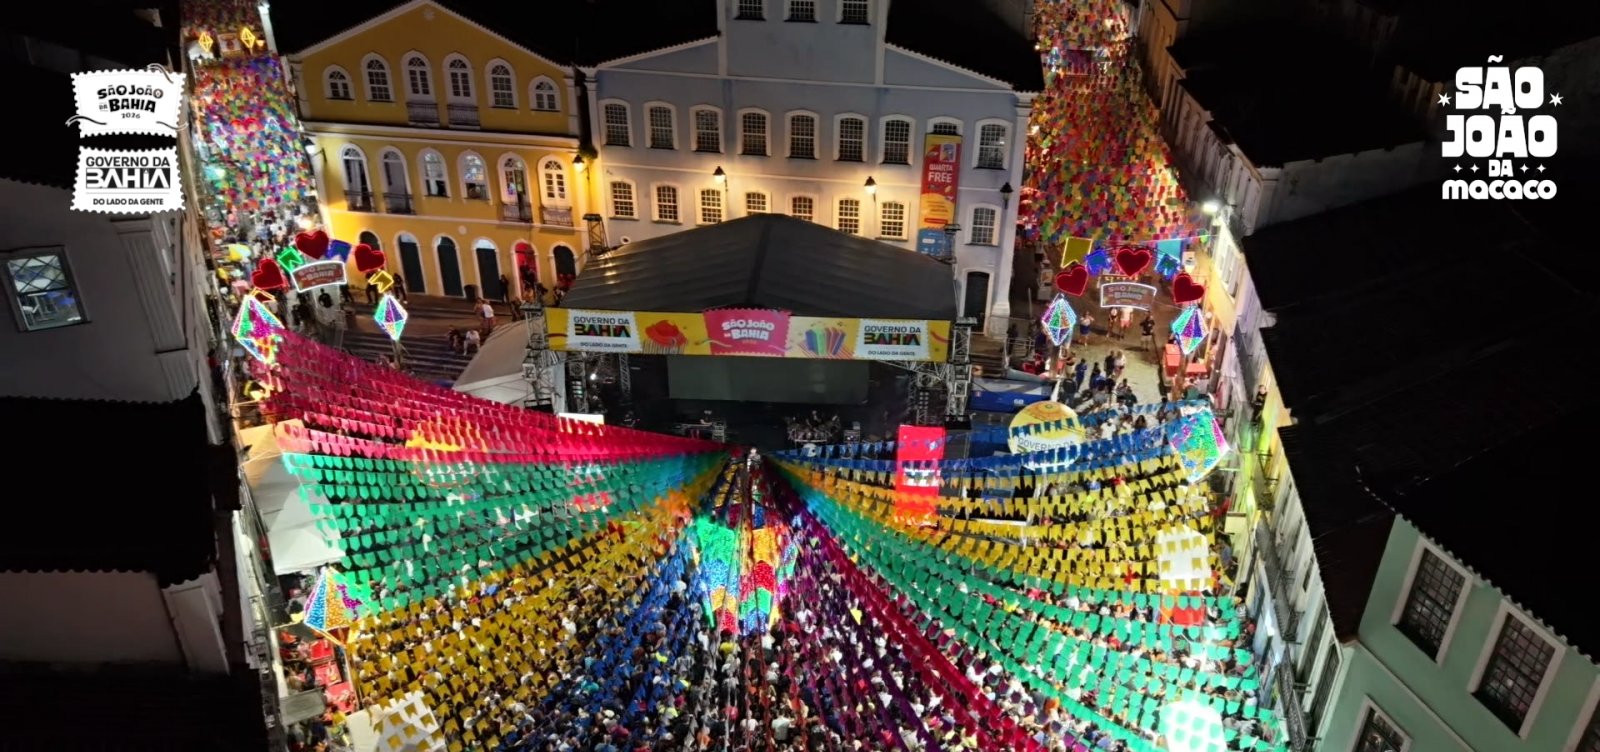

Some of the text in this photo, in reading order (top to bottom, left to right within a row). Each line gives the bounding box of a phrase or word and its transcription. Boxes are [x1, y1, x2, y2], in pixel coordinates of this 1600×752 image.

[928, 163, 953, 172] QUARTA
[928, 171, 953, 183] FREE
[573, 316, 616, 325] GOVERNO
[575, 324, 631, 337] BAHIA
[731, 328, 769, 341] BAHIA
[864, 325, 907, 333] GOVERNO
[864, 333, 921, 345] BAHIA
